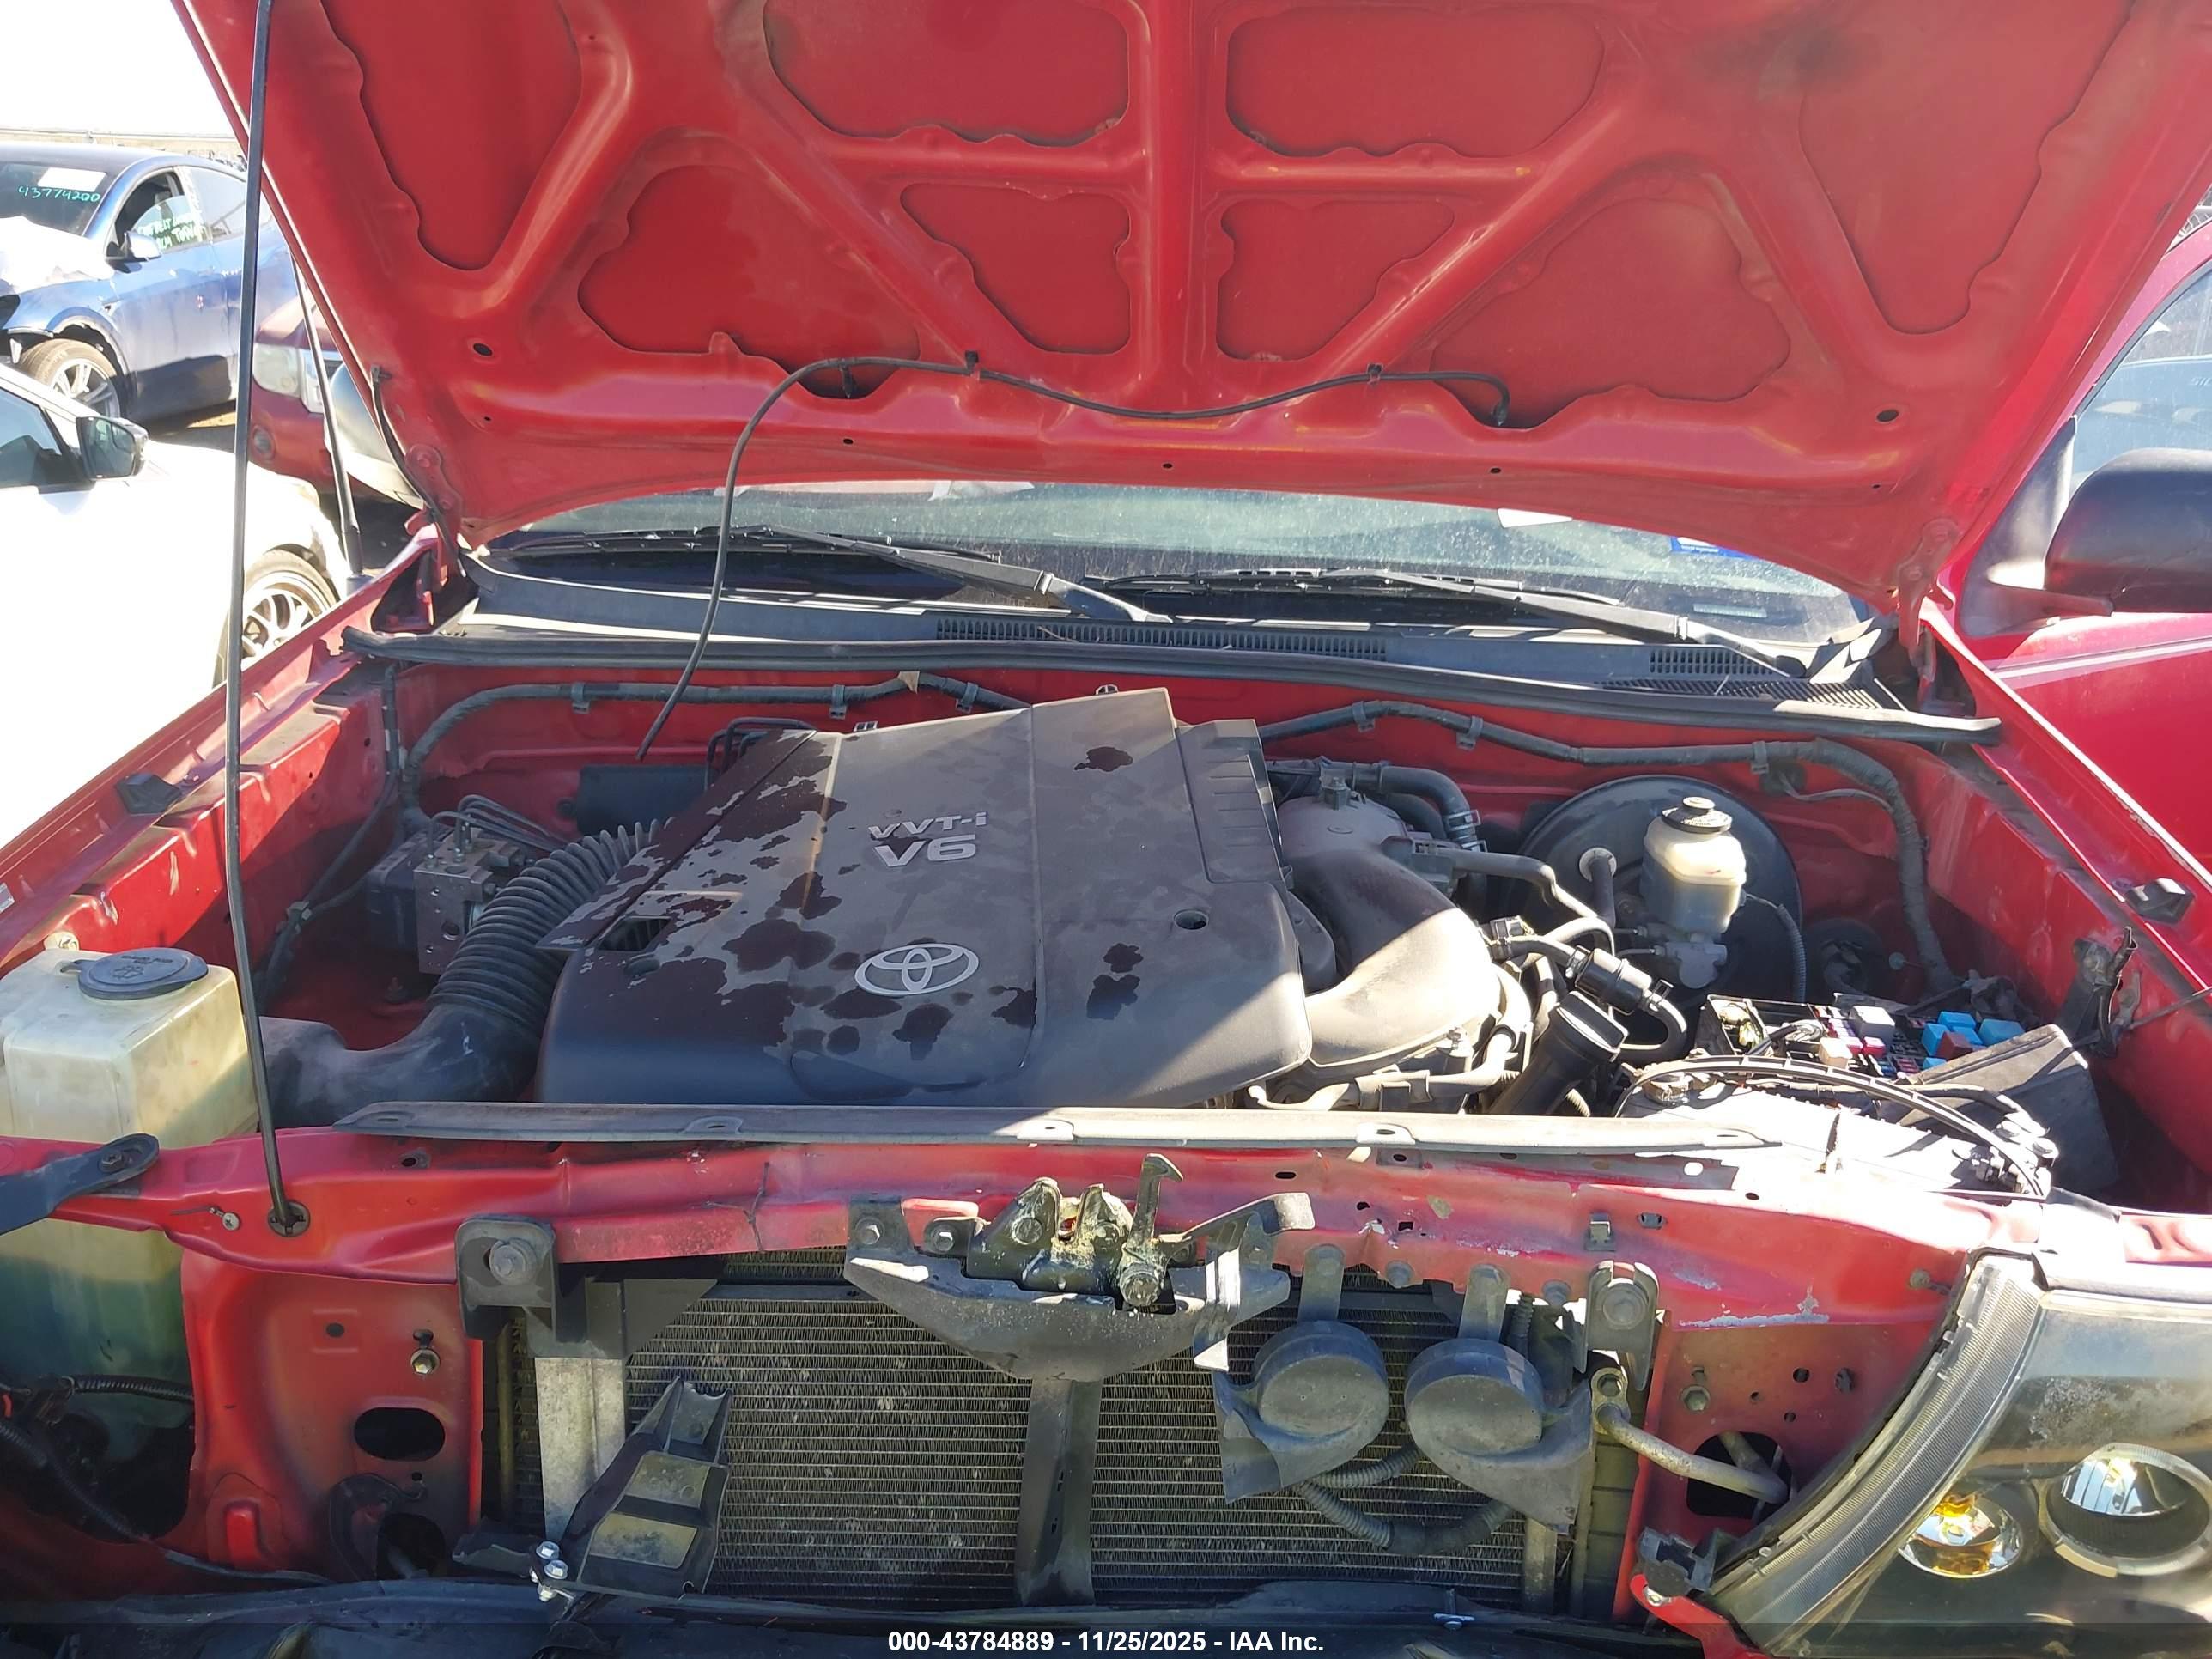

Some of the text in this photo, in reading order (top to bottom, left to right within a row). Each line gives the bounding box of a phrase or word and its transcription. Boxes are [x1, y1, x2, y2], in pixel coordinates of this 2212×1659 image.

[18, 185, 101, 203] 43774200
[868, 811, 988, 839] VVT-i
[874, 834, 976, 867] V6
